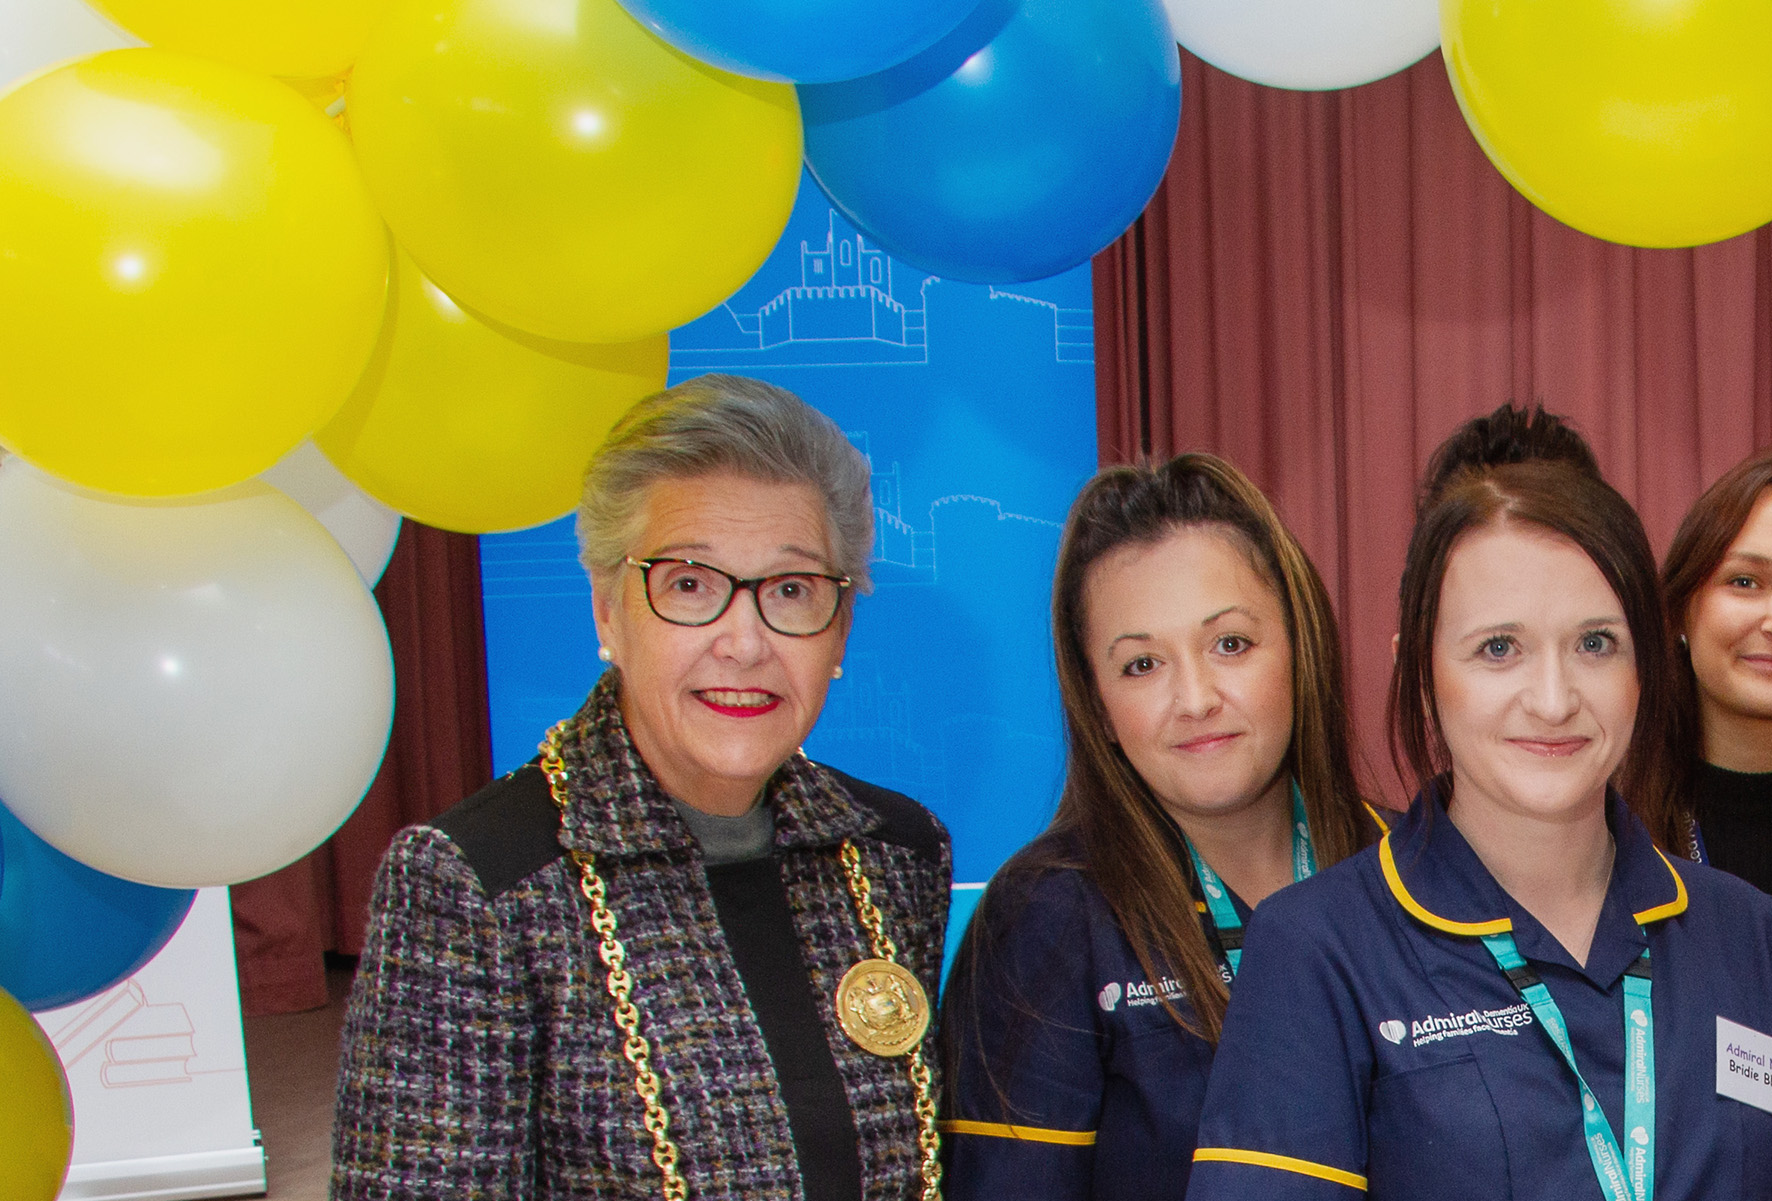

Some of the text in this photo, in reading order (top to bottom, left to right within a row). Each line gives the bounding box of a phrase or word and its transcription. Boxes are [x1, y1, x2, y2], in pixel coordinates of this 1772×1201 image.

[1413, 1031, 1444, 1047] Helping
[1726, 1042, 1765, 1067] Admiral
[1729, 1059, 1759, 1082] Bridie
